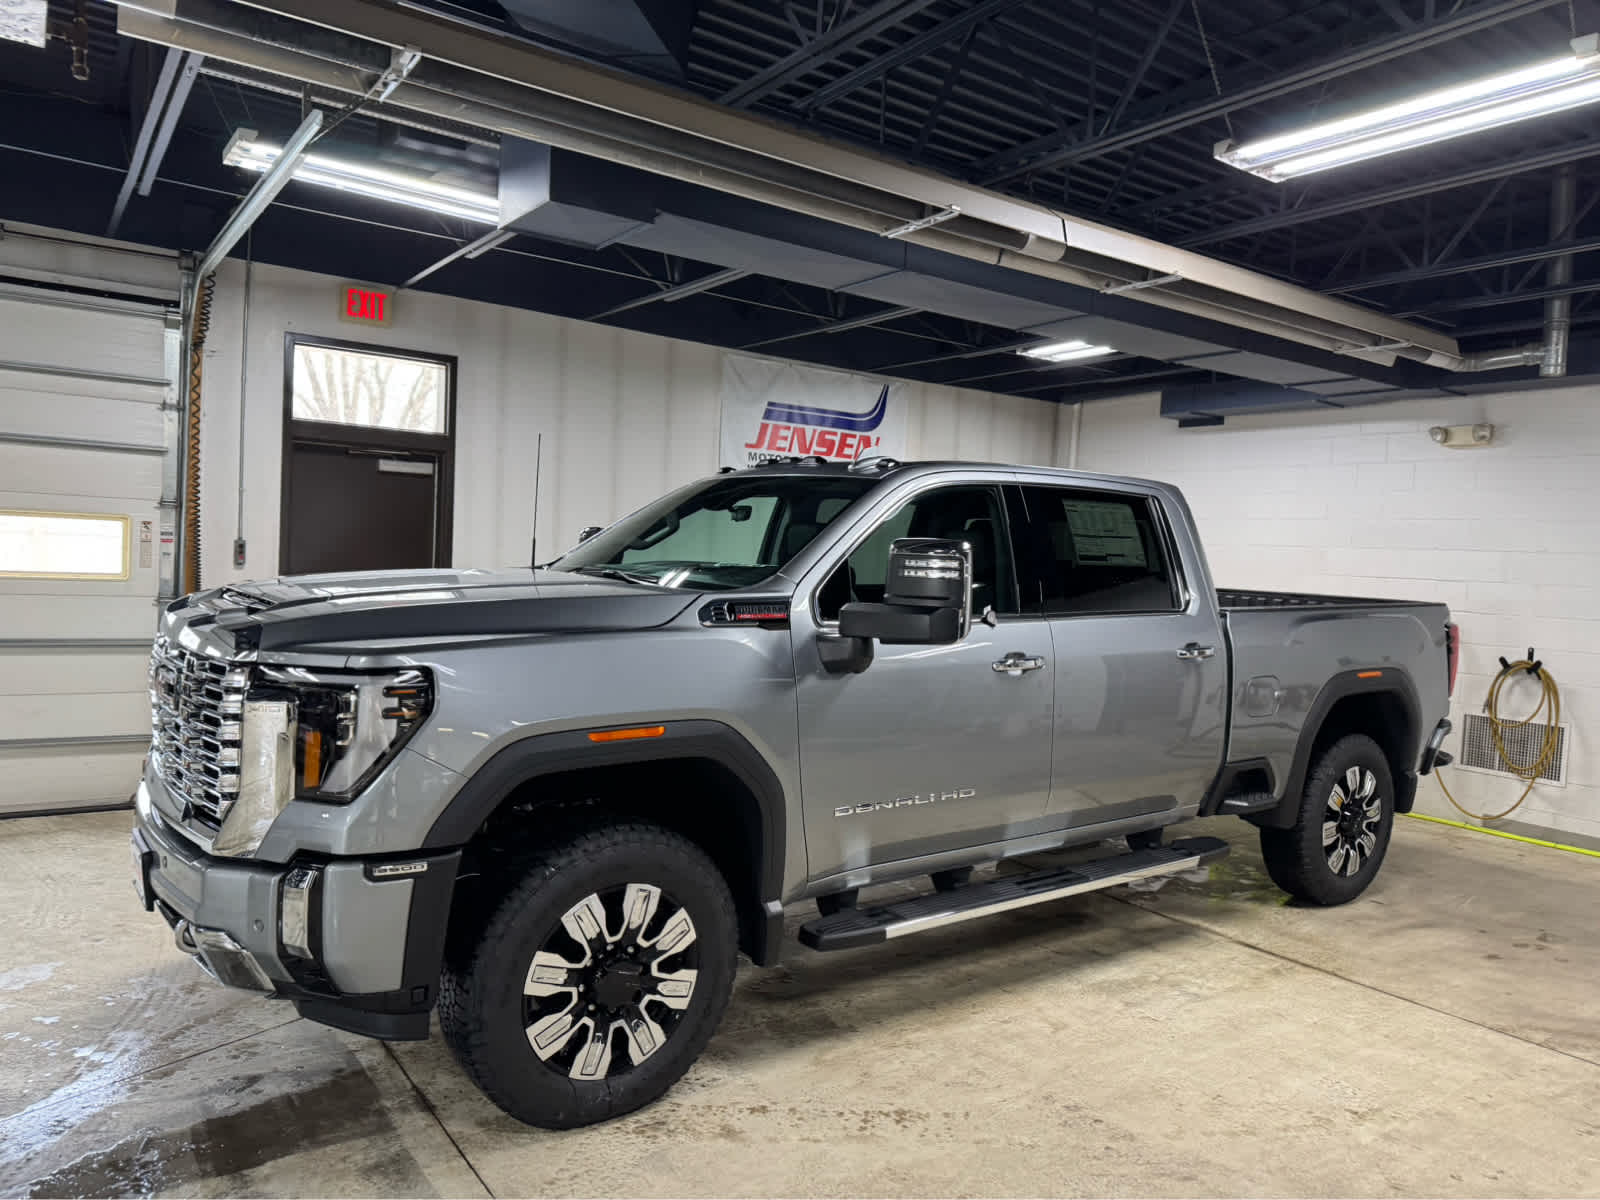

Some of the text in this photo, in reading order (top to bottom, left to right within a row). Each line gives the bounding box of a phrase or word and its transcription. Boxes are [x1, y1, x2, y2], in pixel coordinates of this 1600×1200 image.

[347, 288, 388, 321] EXIT
[834, 788, 976, 817] DENALI HD
